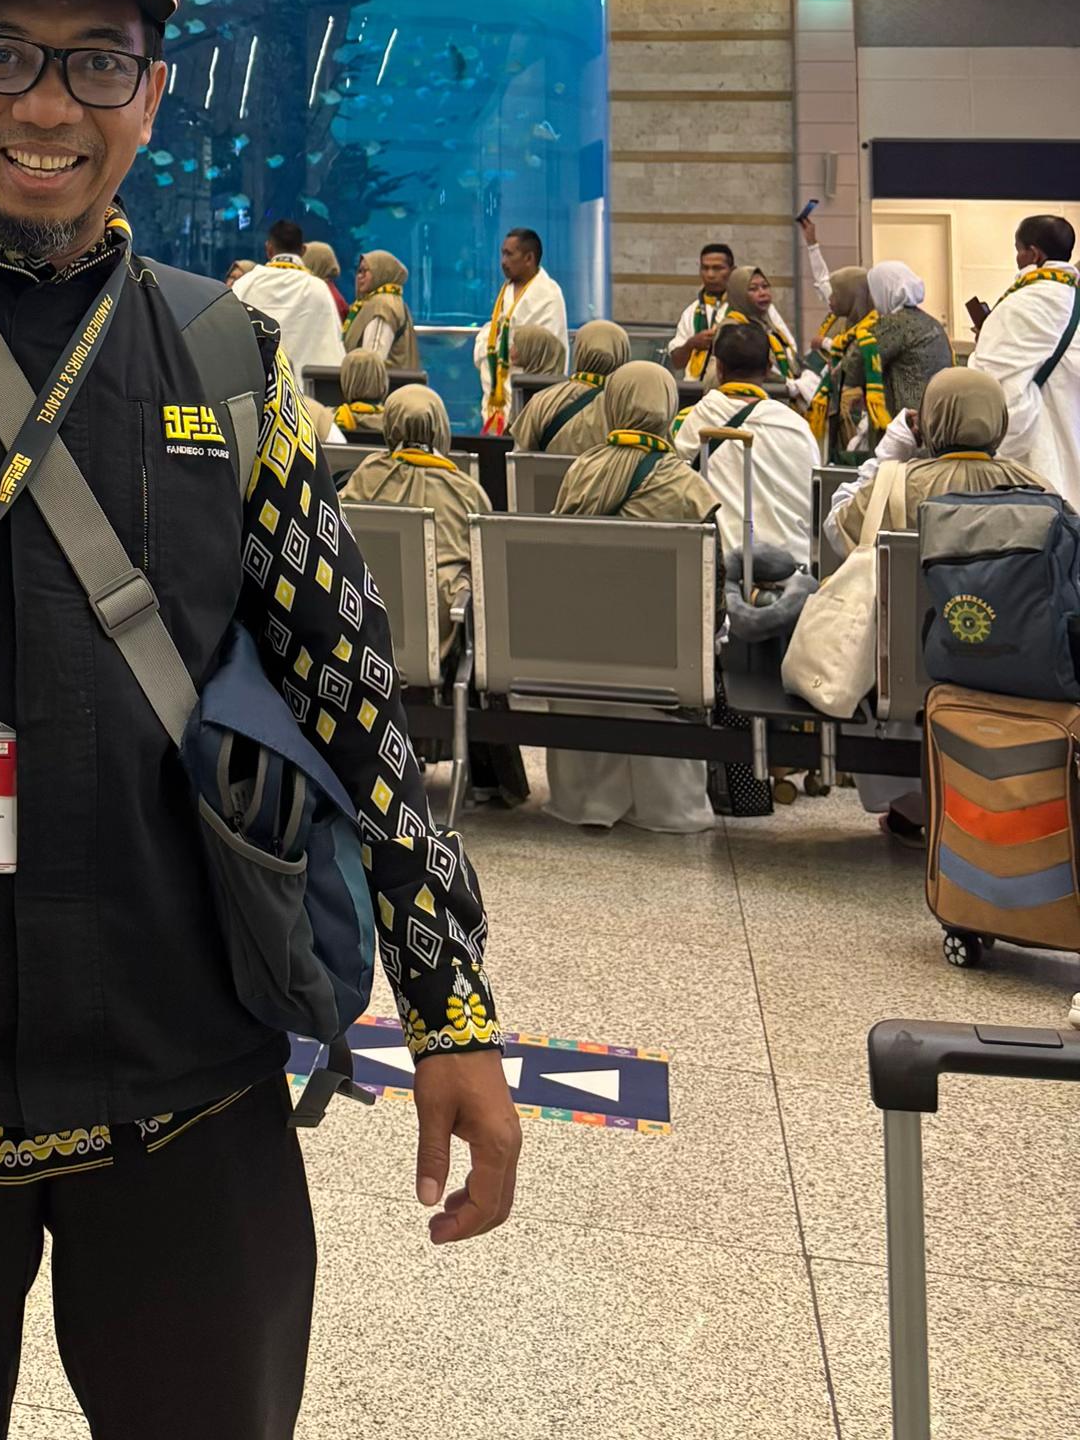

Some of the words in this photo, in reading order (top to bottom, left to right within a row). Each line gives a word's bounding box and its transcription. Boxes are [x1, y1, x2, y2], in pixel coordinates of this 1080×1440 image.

[83, 293, 114, 345] FANDIEGO
[59, 372, 74, 384] &
[64, 338, 92, 378] TOURS
[36, 381, 70, 424] TRAVEL
[166, 445, 205, 456] FANDIEGO
[206, 448, 230, 459] TOURS
